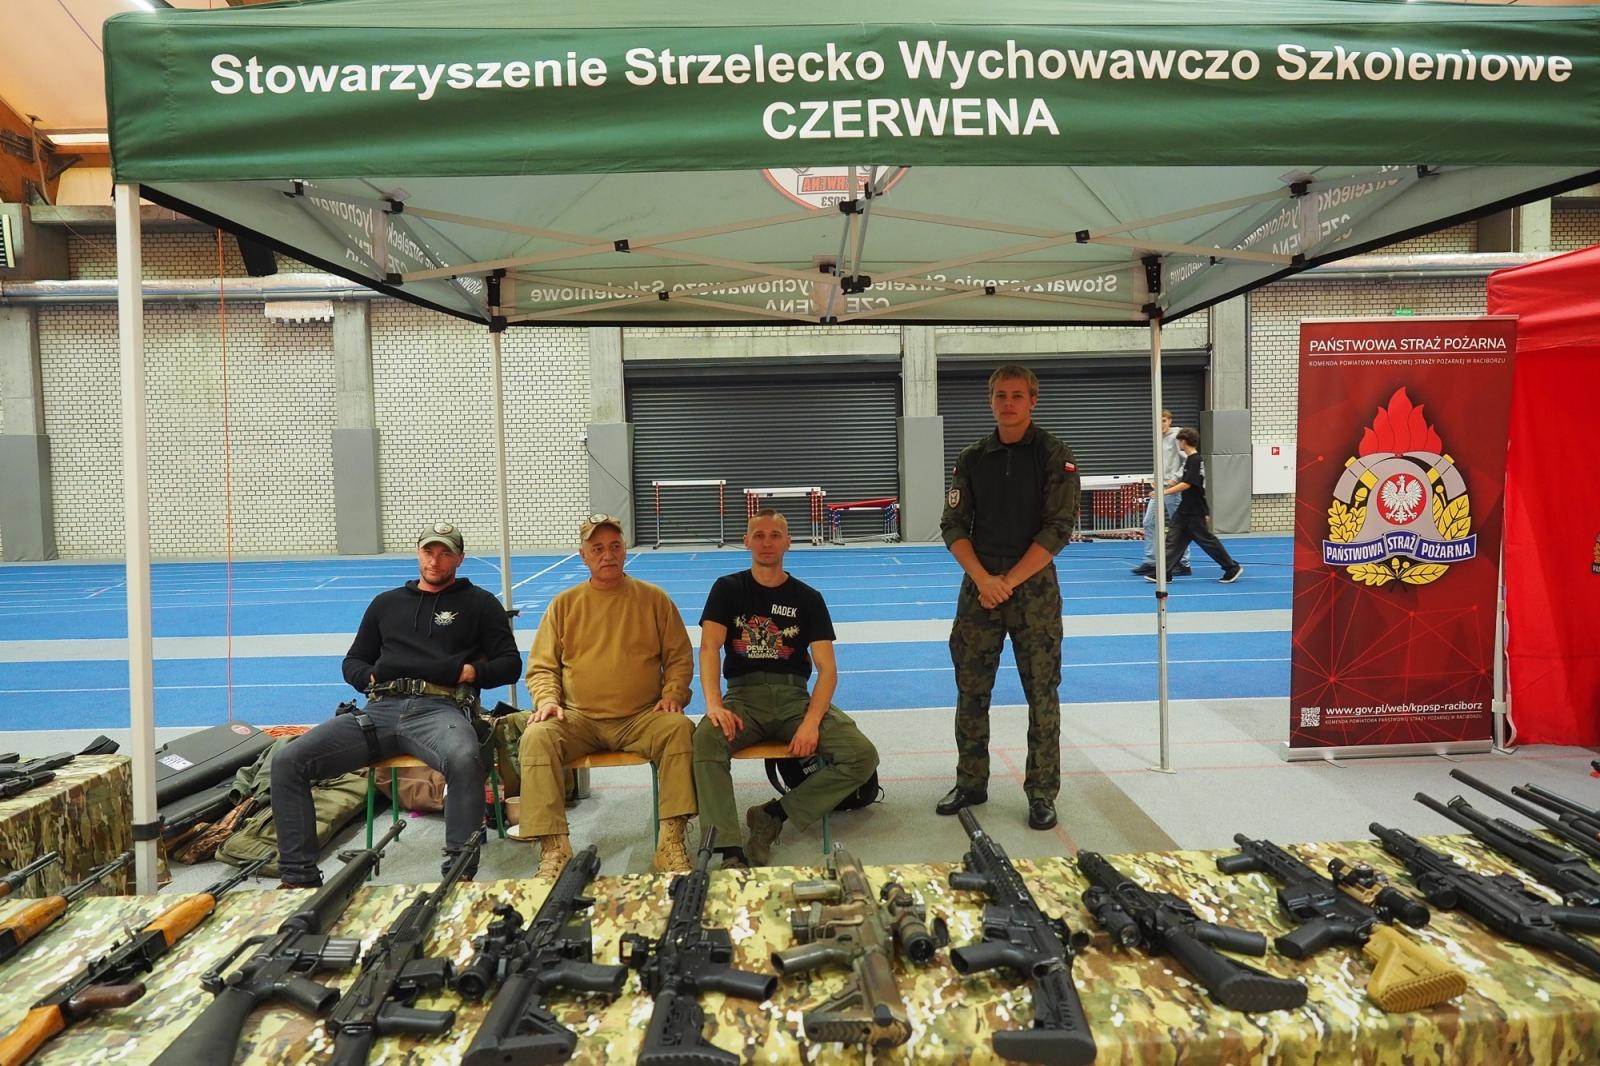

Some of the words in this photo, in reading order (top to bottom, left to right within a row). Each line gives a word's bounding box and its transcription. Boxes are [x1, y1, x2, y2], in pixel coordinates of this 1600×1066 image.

[209, 51, 607, 101] Stowarzyszenie
[624, 42, 885, 86] Strzelecko
[898, 40, 1260, 90] Wychowawczo
[1276, 43, 1574, 83] Szkoleniowe
[762, 97, 1061, 140] CZERWENA
[1309, 336, 1398, 352] PAŃSTWOWA
[1400, 335, 1440, 351] STRAŻ
[1444, 335, 1506, 350] POŻARNA
[1326, 542, 1384, 561] PAŃSTWOWA
[1387, 535, 1416, 550] STRAŻ
[1421, 542, 1471, 559] POŻARNA
[771, 604, 798, 618] RADEK
[1325, 700, 1483, 716] www.gov.pl/web/kppsp-raciborz
